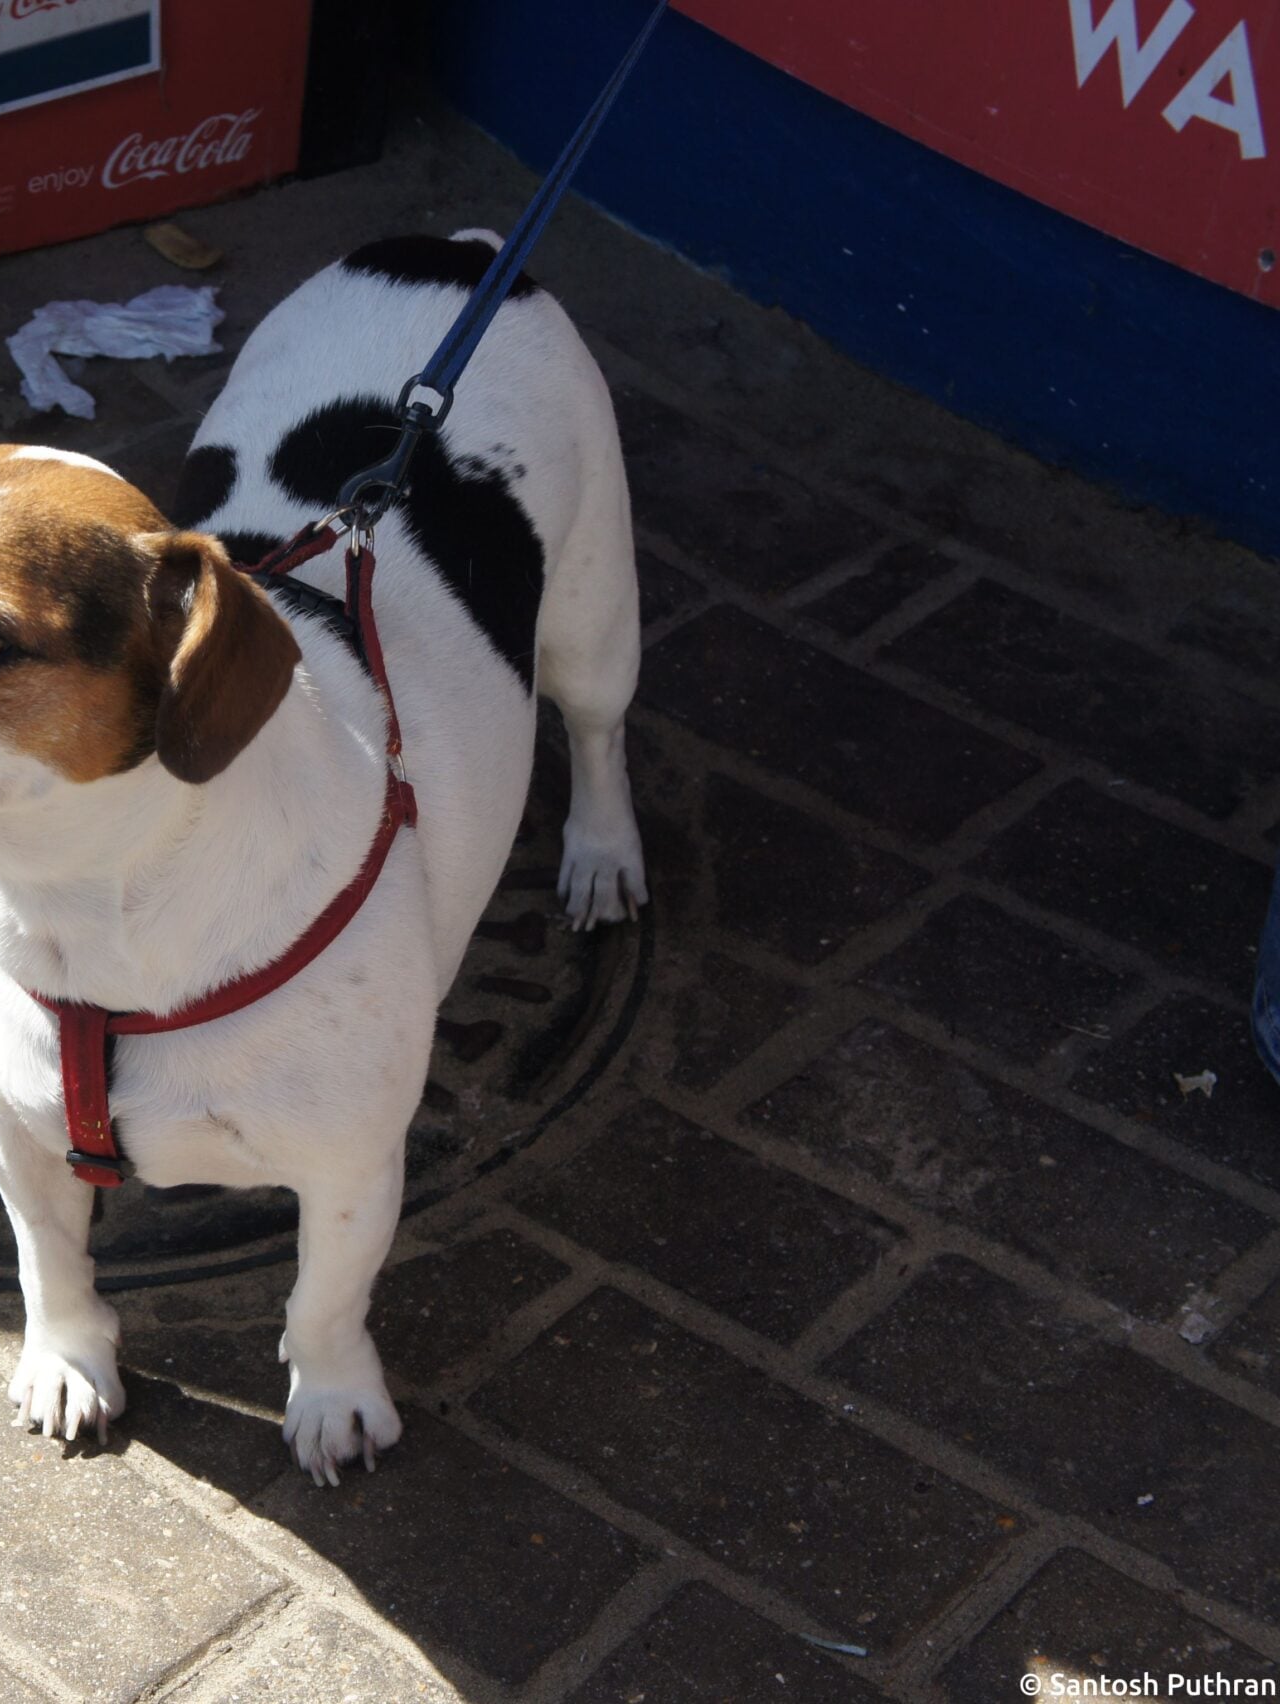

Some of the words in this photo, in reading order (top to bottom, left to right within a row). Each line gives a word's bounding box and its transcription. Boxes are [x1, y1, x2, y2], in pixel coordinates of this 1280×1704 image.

[1067, 0, 1267, 161] WA
[27, 164, 95, 194] enjoy
[101, 108, 263, 190] Coca-Cola
